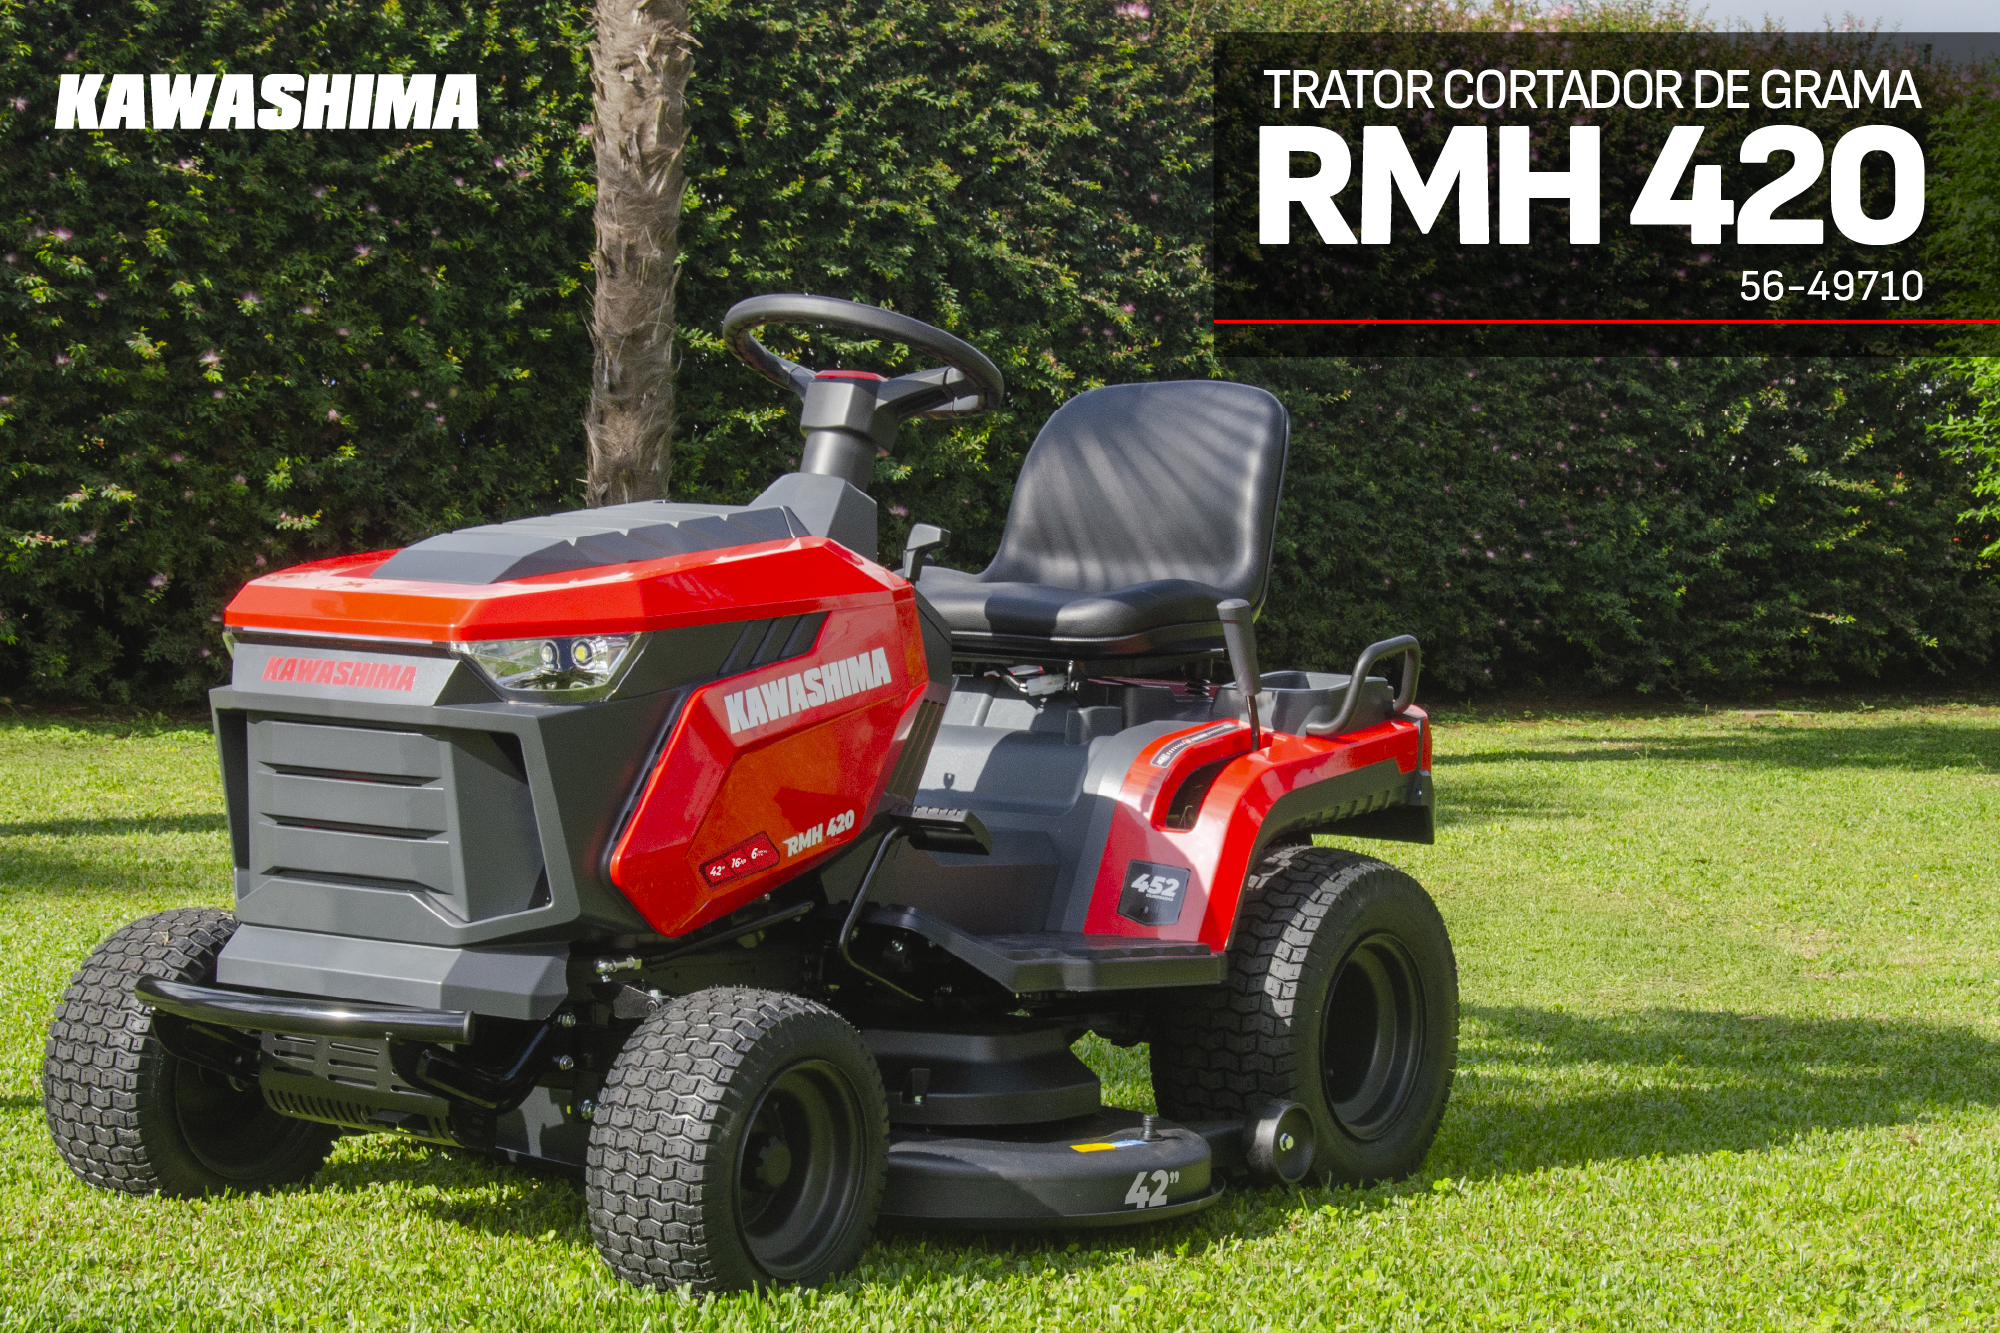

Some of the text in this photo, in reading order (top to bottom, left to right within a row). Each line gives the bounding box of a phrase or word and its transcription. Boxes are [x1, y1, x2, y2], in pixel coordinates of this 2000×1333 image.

[262, 656, 417, 691] KAWASHIMA
[724, 646, 892, 734] KAWASHIMA
[782, 809, 855, 857] RMH 420
[1131, 873, 1180, 897] 452
